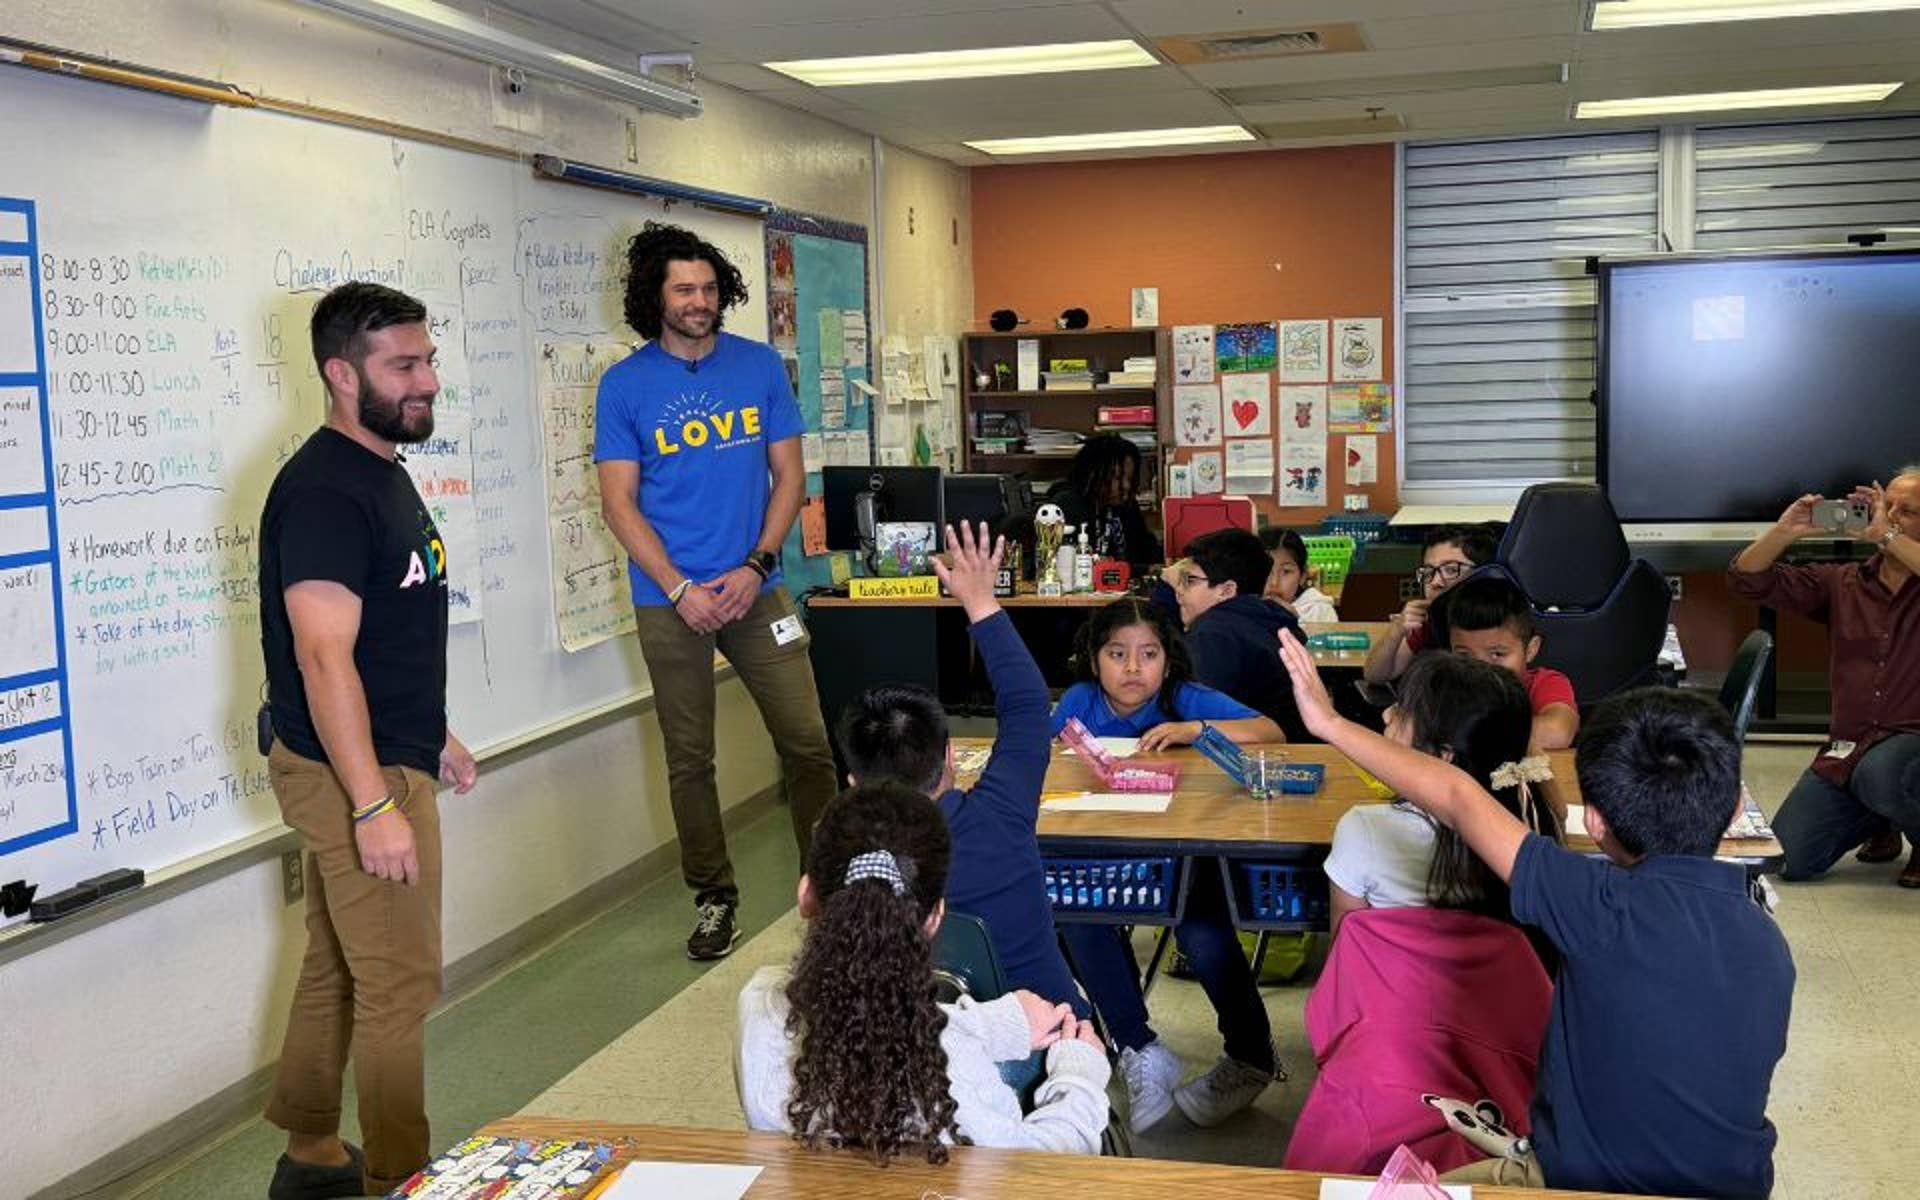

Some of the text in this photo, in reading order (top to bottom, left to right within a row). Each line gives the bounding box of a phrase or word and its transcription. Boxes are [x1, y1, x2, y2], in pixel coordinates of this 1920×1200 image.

[409, 209, 492, 249] ELA Cognates
[152, 372, 200, 391] Lunch
[157, 408, 199, 432] Math
[655, 407, 761, 454] LOVE
[159, 456, 200, 479] Math
[84, 533, 156, 563] Homework
[164, 528, 188, 555] due
[85, 569, 137, 596] Gators
[112, 806, 157, 843] Field
[165, 791, 198, 829] Day
[201, 791, 219, 811] on
